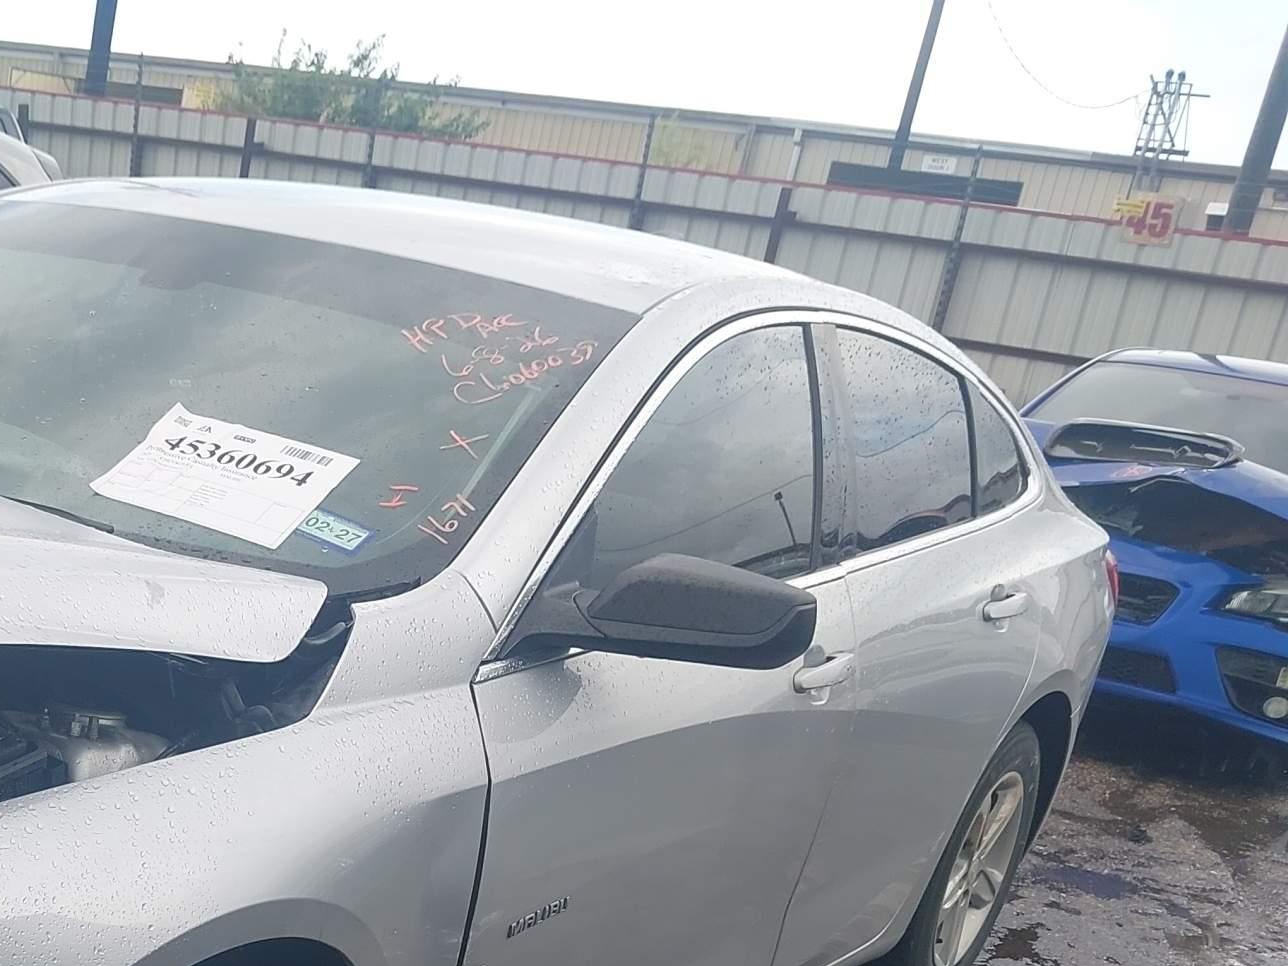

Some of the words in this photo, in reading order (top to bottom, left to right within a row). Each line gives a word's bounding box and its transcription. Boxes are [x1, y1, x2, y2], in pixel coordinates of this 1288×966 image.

[164, 435, 315, 487] 45360694
[334, 528, 363, 543] 27
[506, 896, 570, 939] MALIBU
